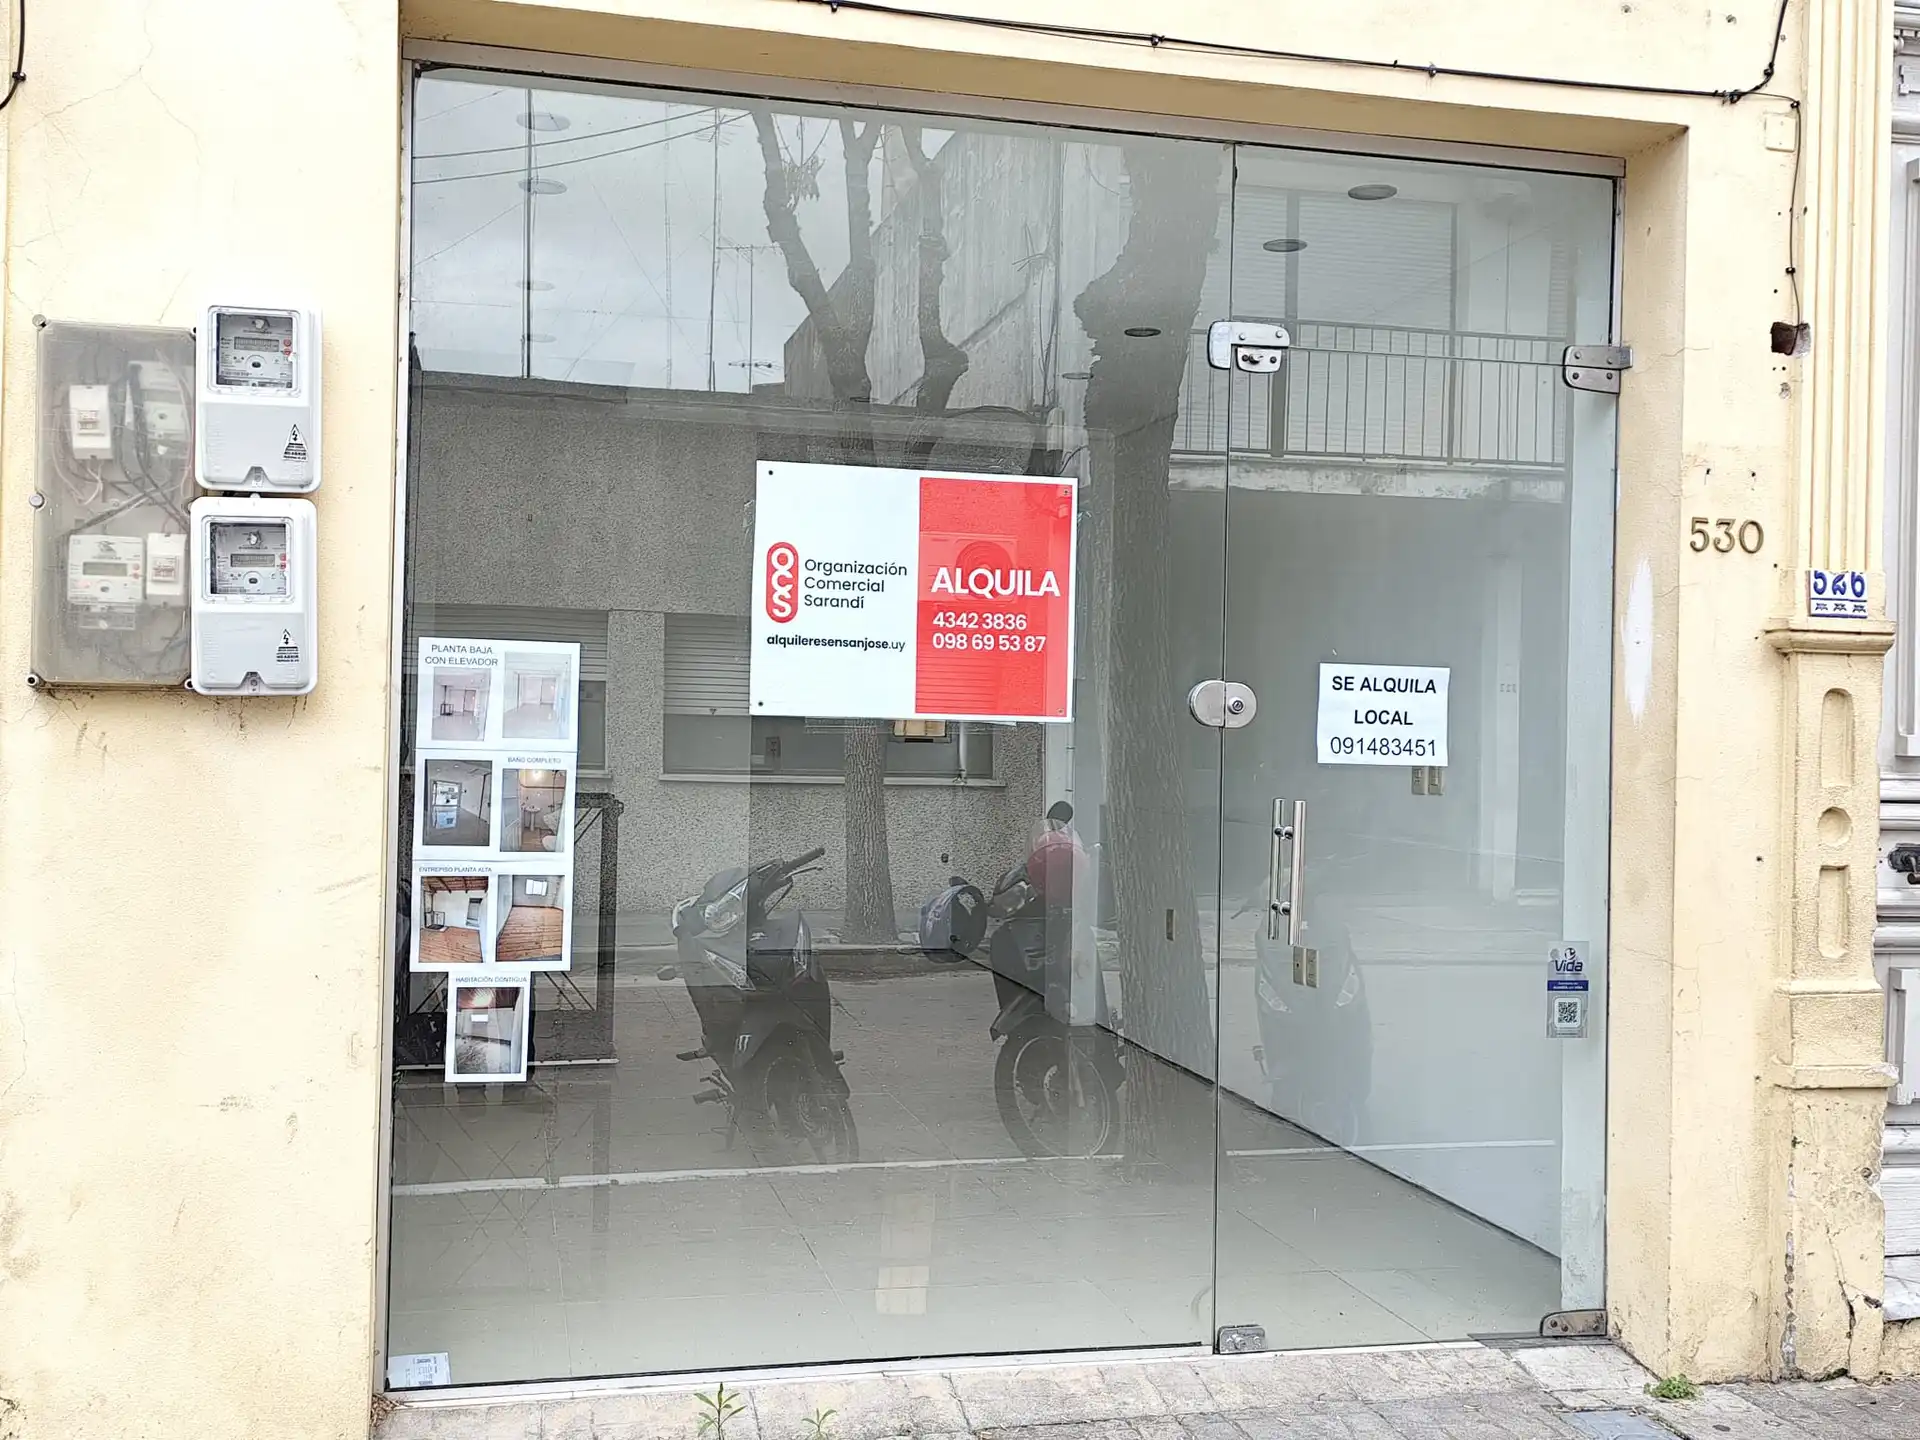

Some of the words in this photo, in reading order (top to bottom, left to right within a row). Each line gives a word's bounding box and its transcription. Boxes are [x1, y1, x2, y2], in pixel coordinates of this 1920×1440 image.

[1689, 516, 1765, 554] 530
[804, 558, 908, 578] Organización
[804, 576, 885, 593] Comercial
[930, 567, 1061, 599] ALQUILA
[804, 594, 865, 609] Sarandí
[932, 611, 978, 630] 4342
[982, 612, 1027, 631] 3836
[431, 644, 467, 654] PLANTA
[469, 645, 493, 655] BAJA
[766, 634, 906, 653] alquileresensanjose.uy
[932, 633, 968, 650] 098
[971, 634, 995, 651] 69
[999, 634, 1021, 652] 53
[1024, 635, 1046, 653] 87
[424, 656, 446, 665] CON
[448, 657, 498, 666] ELEVADOR
[1332, 675, 1355, 691] SE
[1359, 676, 1437, 694] ALQUILA
[1354, 709, 1414, 726] LOCAL
[1330, 736, 1436, 757] 091483451
[1554, 959, 1583, 972] Vida
[455, 975, 493, 983] HABITACIÓN
